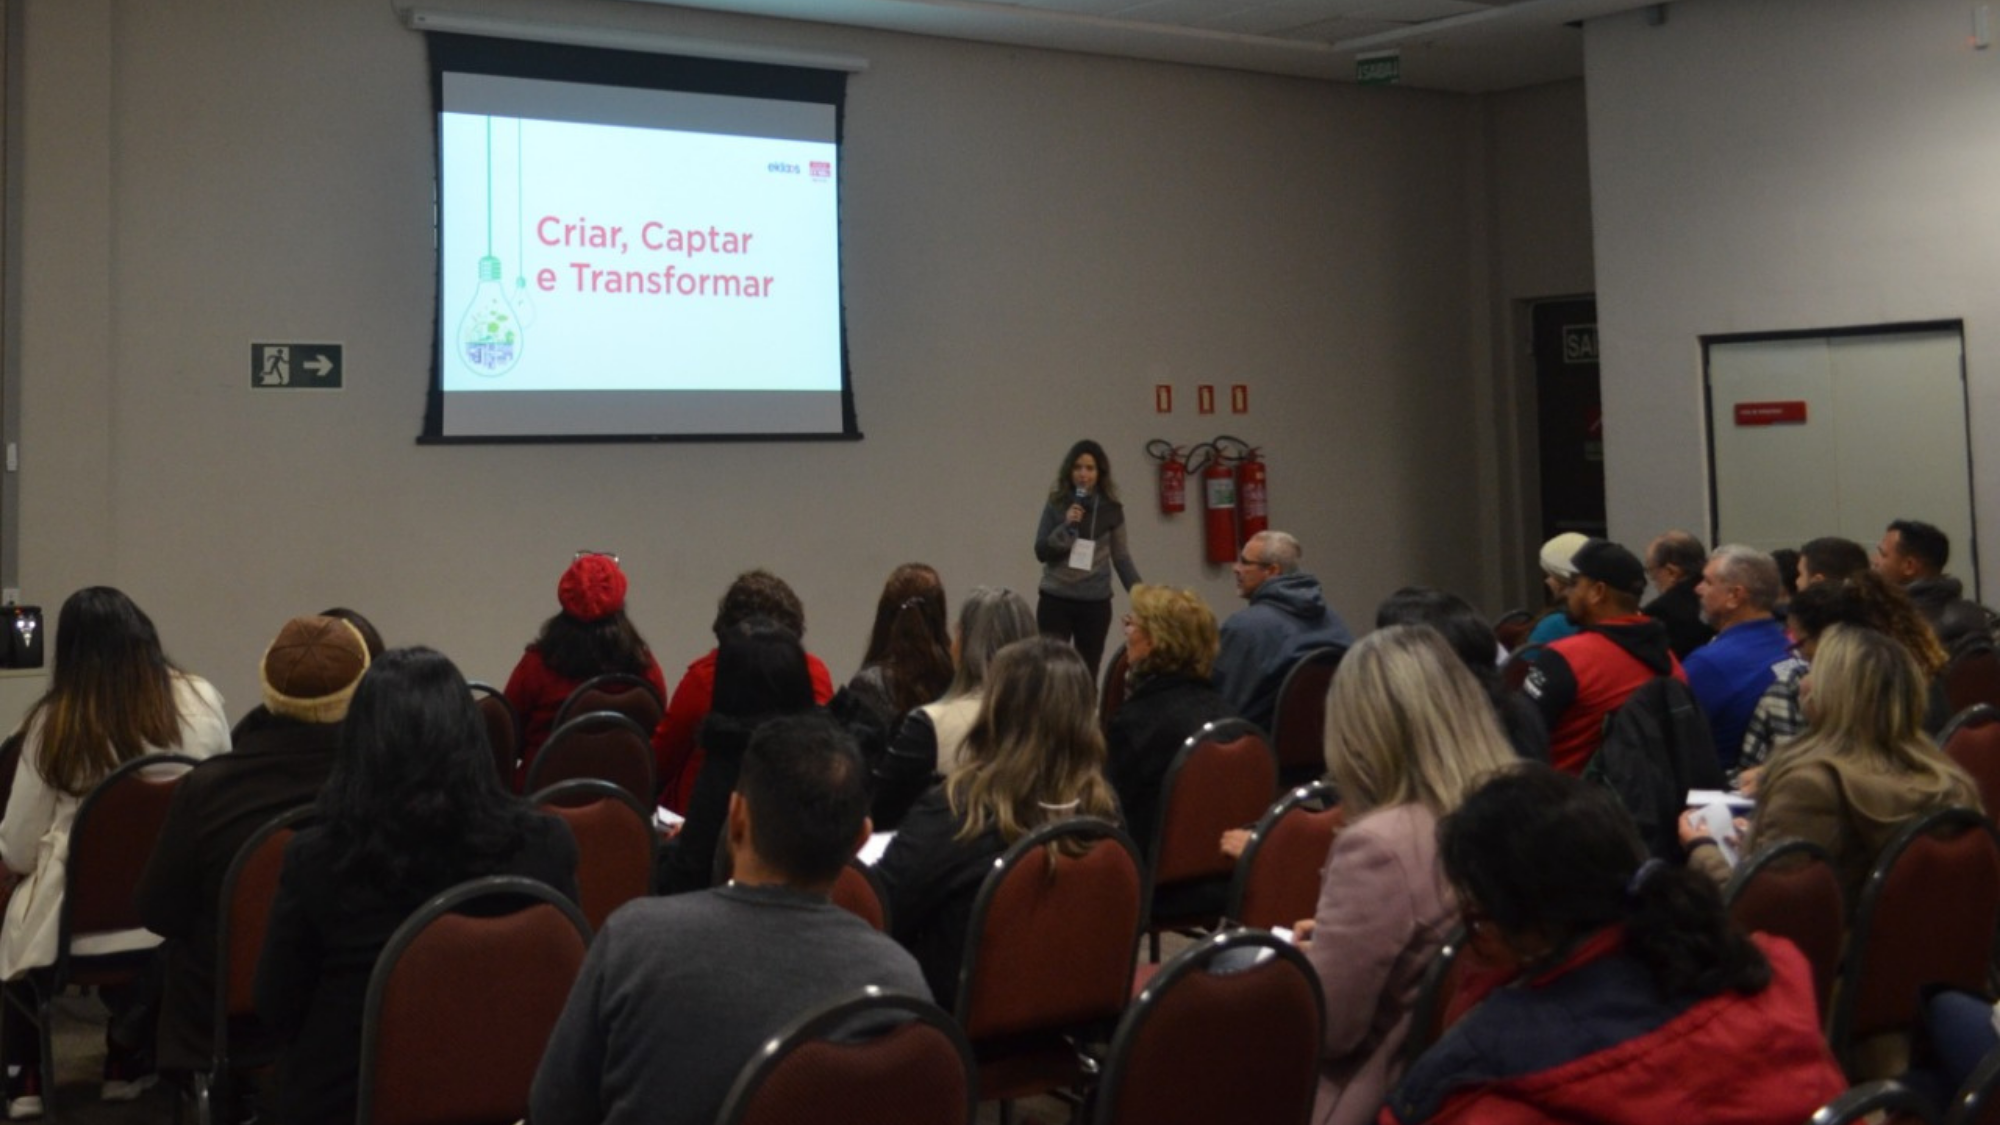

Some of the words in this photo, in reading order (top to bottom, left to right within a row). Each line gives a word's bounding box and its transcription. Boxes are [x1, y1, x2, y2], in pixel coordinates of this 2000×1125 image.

[537, 216, 628, 254] Criar,
[641, 221, 752, 257] Captar
[537, 268, 556, 291] e
[570, 263, 774, 297] Transformar
